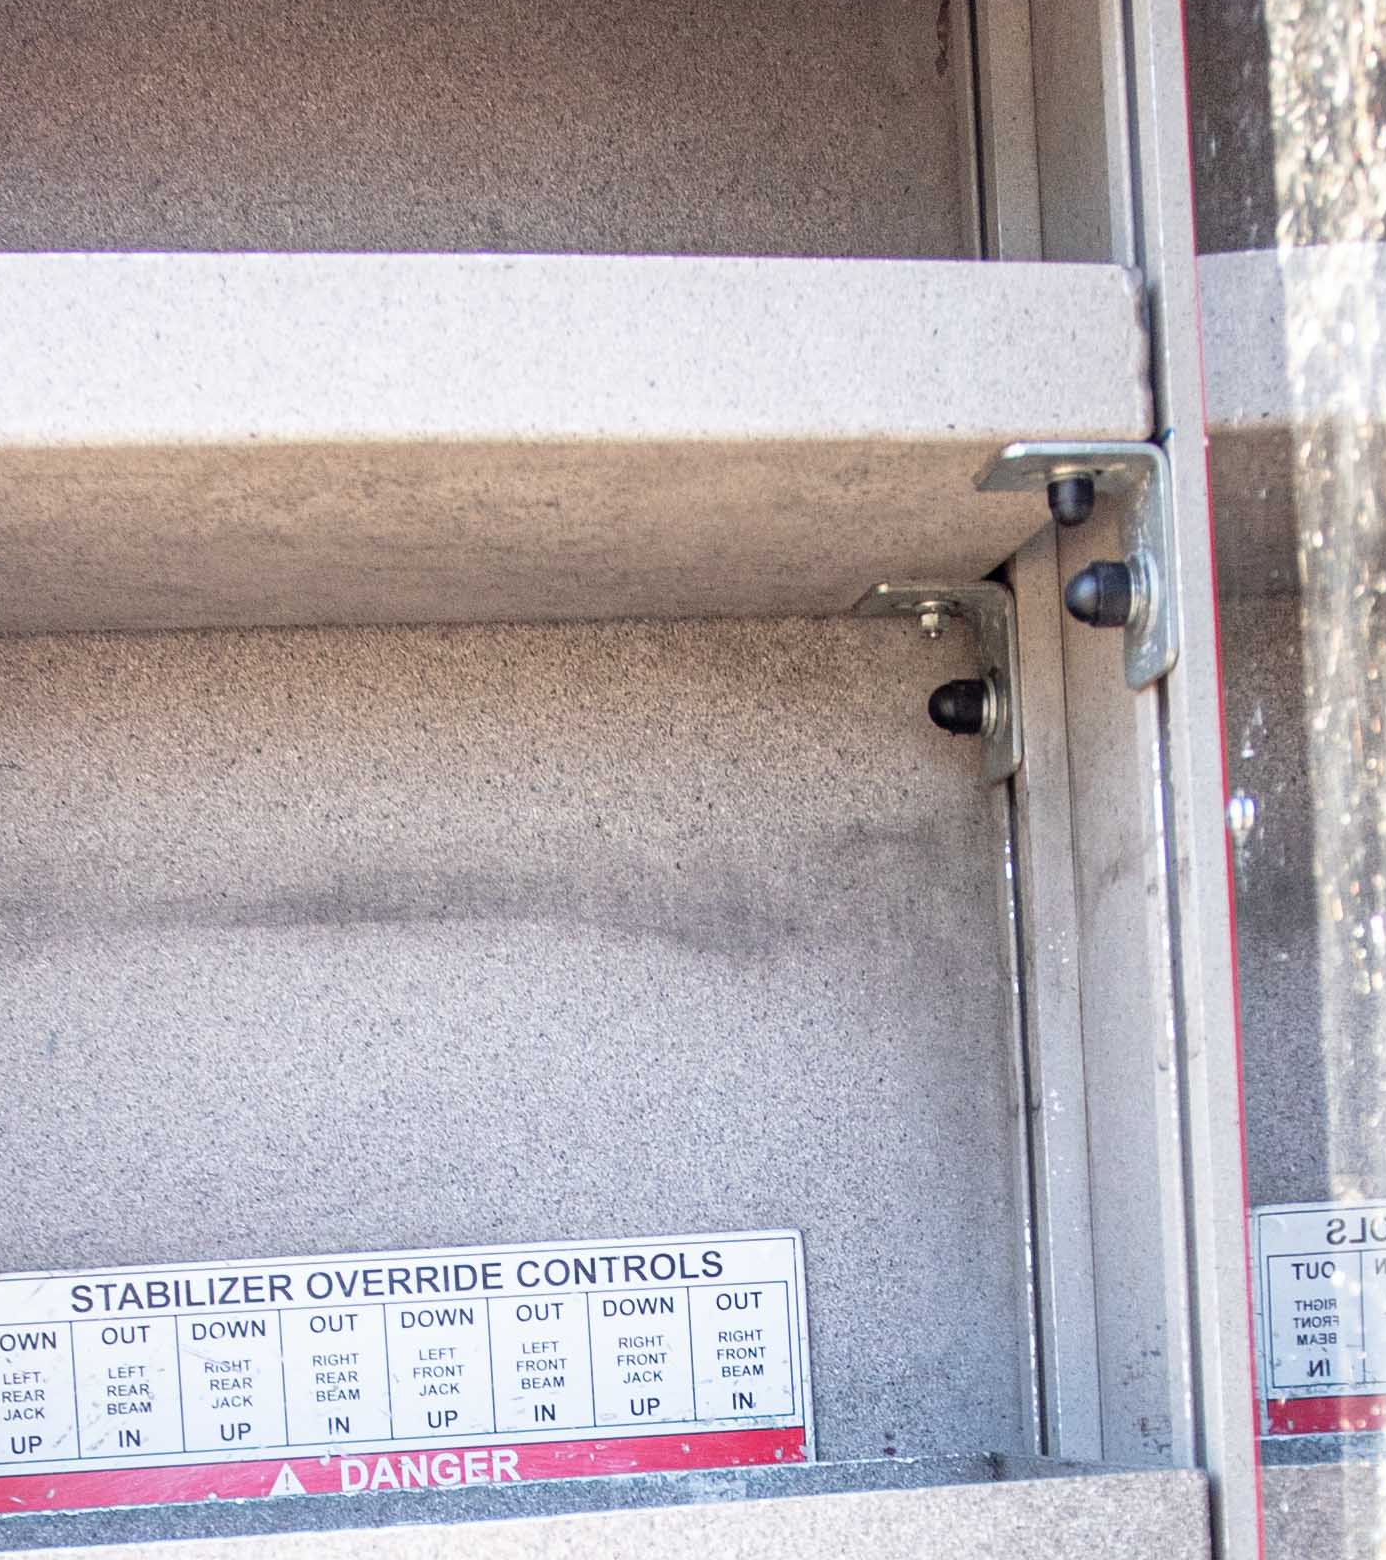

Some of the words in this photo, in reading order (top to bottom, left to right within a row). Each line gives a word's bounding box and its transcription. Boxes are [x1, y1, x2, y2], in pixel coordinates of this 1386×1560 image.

[71, 1273, 294, 1313] STABILIZER
[306, 1262, 504, 1300] OVERRIDE
[516, 1250, 725, 1289] CONTROLS
[603, 1296, 674, 1317] DOWN
[716, 1291, 763, 1310] OUT
[401, 1308, 473, 1328] DOWN
[516, 1303, 564, 1322] OUT
[192, 1320, 265, 1340] DOWN
[310, 1314, 358, 1333] OUT
[102, 1325, 150, 1345] OUT
[619, 1335, 663, 1349] RIGHT
[719, 1329, 763, 1343] RIGHT
[419, 1347, 455, 1360] LEFT
[523, 1341, 558, 1354] LEFT
[717, 1346, 766, 1360] FRONT
[313, 1353, 358, 1366] RIGHT
[517, 1358, 567, 1372] FRONT
[617, 1352, 667, 1366] FRONT
[108, 1366, 145, 1379] LEFT
[205, 1360, 251, 1373] RIGHT
[413, 1365, 463, 1378] FRONT
[721, 1364, 764, 1378] BEAM
[3, 1371, 41, 1385] LEFT
[210, 1377, 252, 1391] REAR
[316, 1371, 358, 1384] REAR
[521, 1376, 564, 1389] BEAM
[623, 1371, 663, 1384] JACK
[2, 1389, 45, 1403] REAR
[107, 1384, 150, 1398] REAR
[316, 1388, 360, 1402] BEAM
[419, 1383, 460, 1396] JACK
[212, 1395, 253, 1409] JACK
[631, 1398, 660, 1416] UP
[733, 1392, 753, 1410] IN
[3, 1407, 45, 1421] JACK
[107, 1402, 152, 1415] BEAM
[534, 1404, 555, 1422] IN
[328, 1416, 349, 1435] IN
[427, 1410, 458, 1428] UP
[118, 1429, 141, 1448] IN
[221, 1423, 251, 1441] UP
[11, 1436, 42, 1454] UP
[341, 1450, 521, 1492] DANGER
